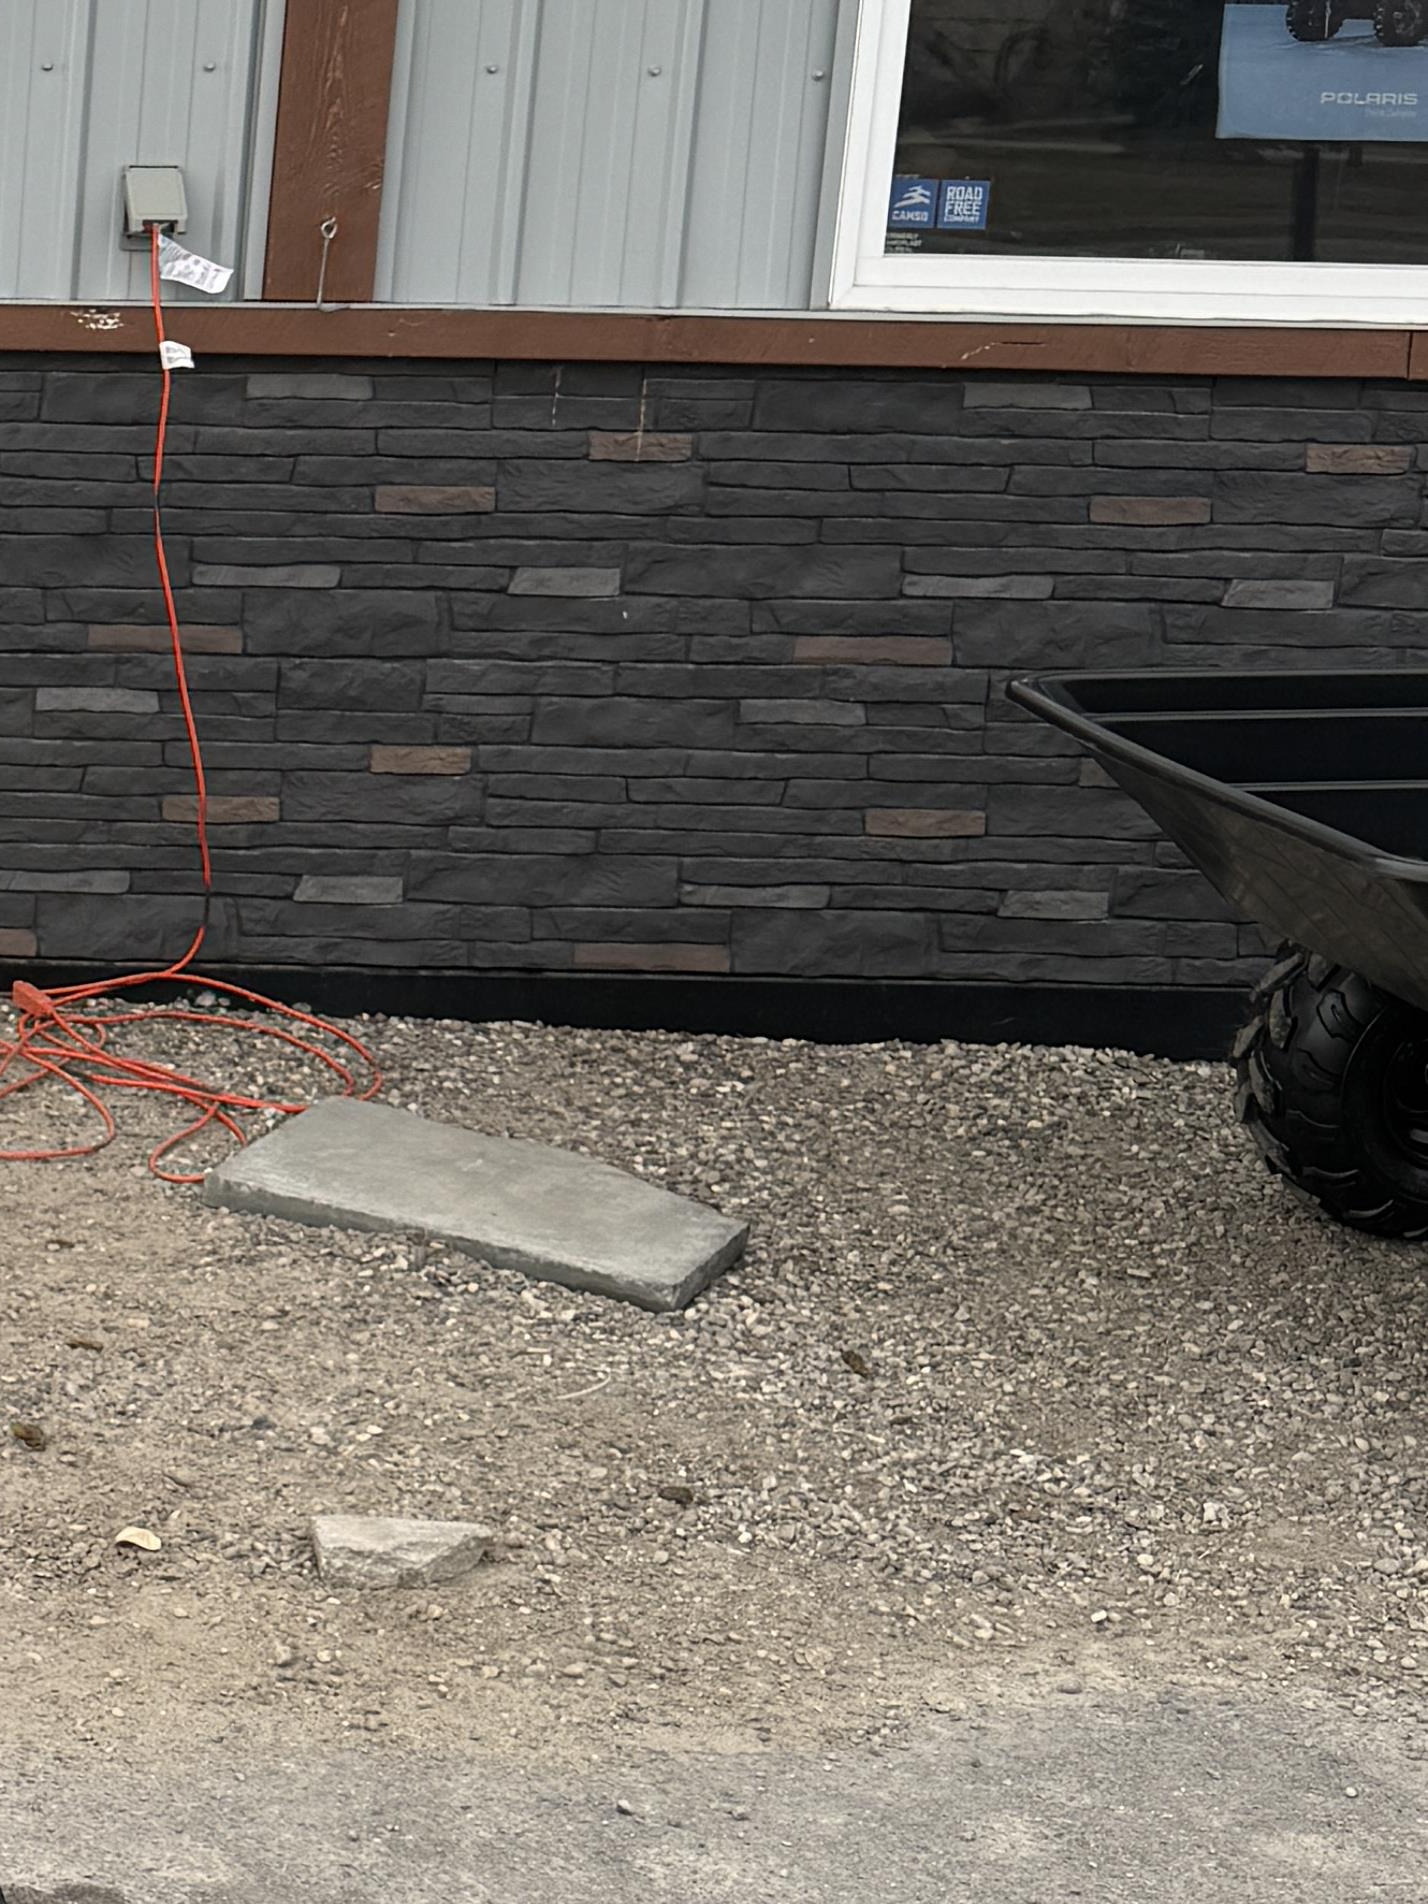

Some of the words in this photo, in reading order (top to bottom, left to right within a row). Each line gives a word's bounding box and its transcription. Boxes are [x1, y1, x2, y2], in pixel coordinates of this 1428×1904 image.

[1320, 92, 1418, 105] POLARIS
[947, 186, 983, 200] ROAD
[944, 201, 982, 216] FREE
